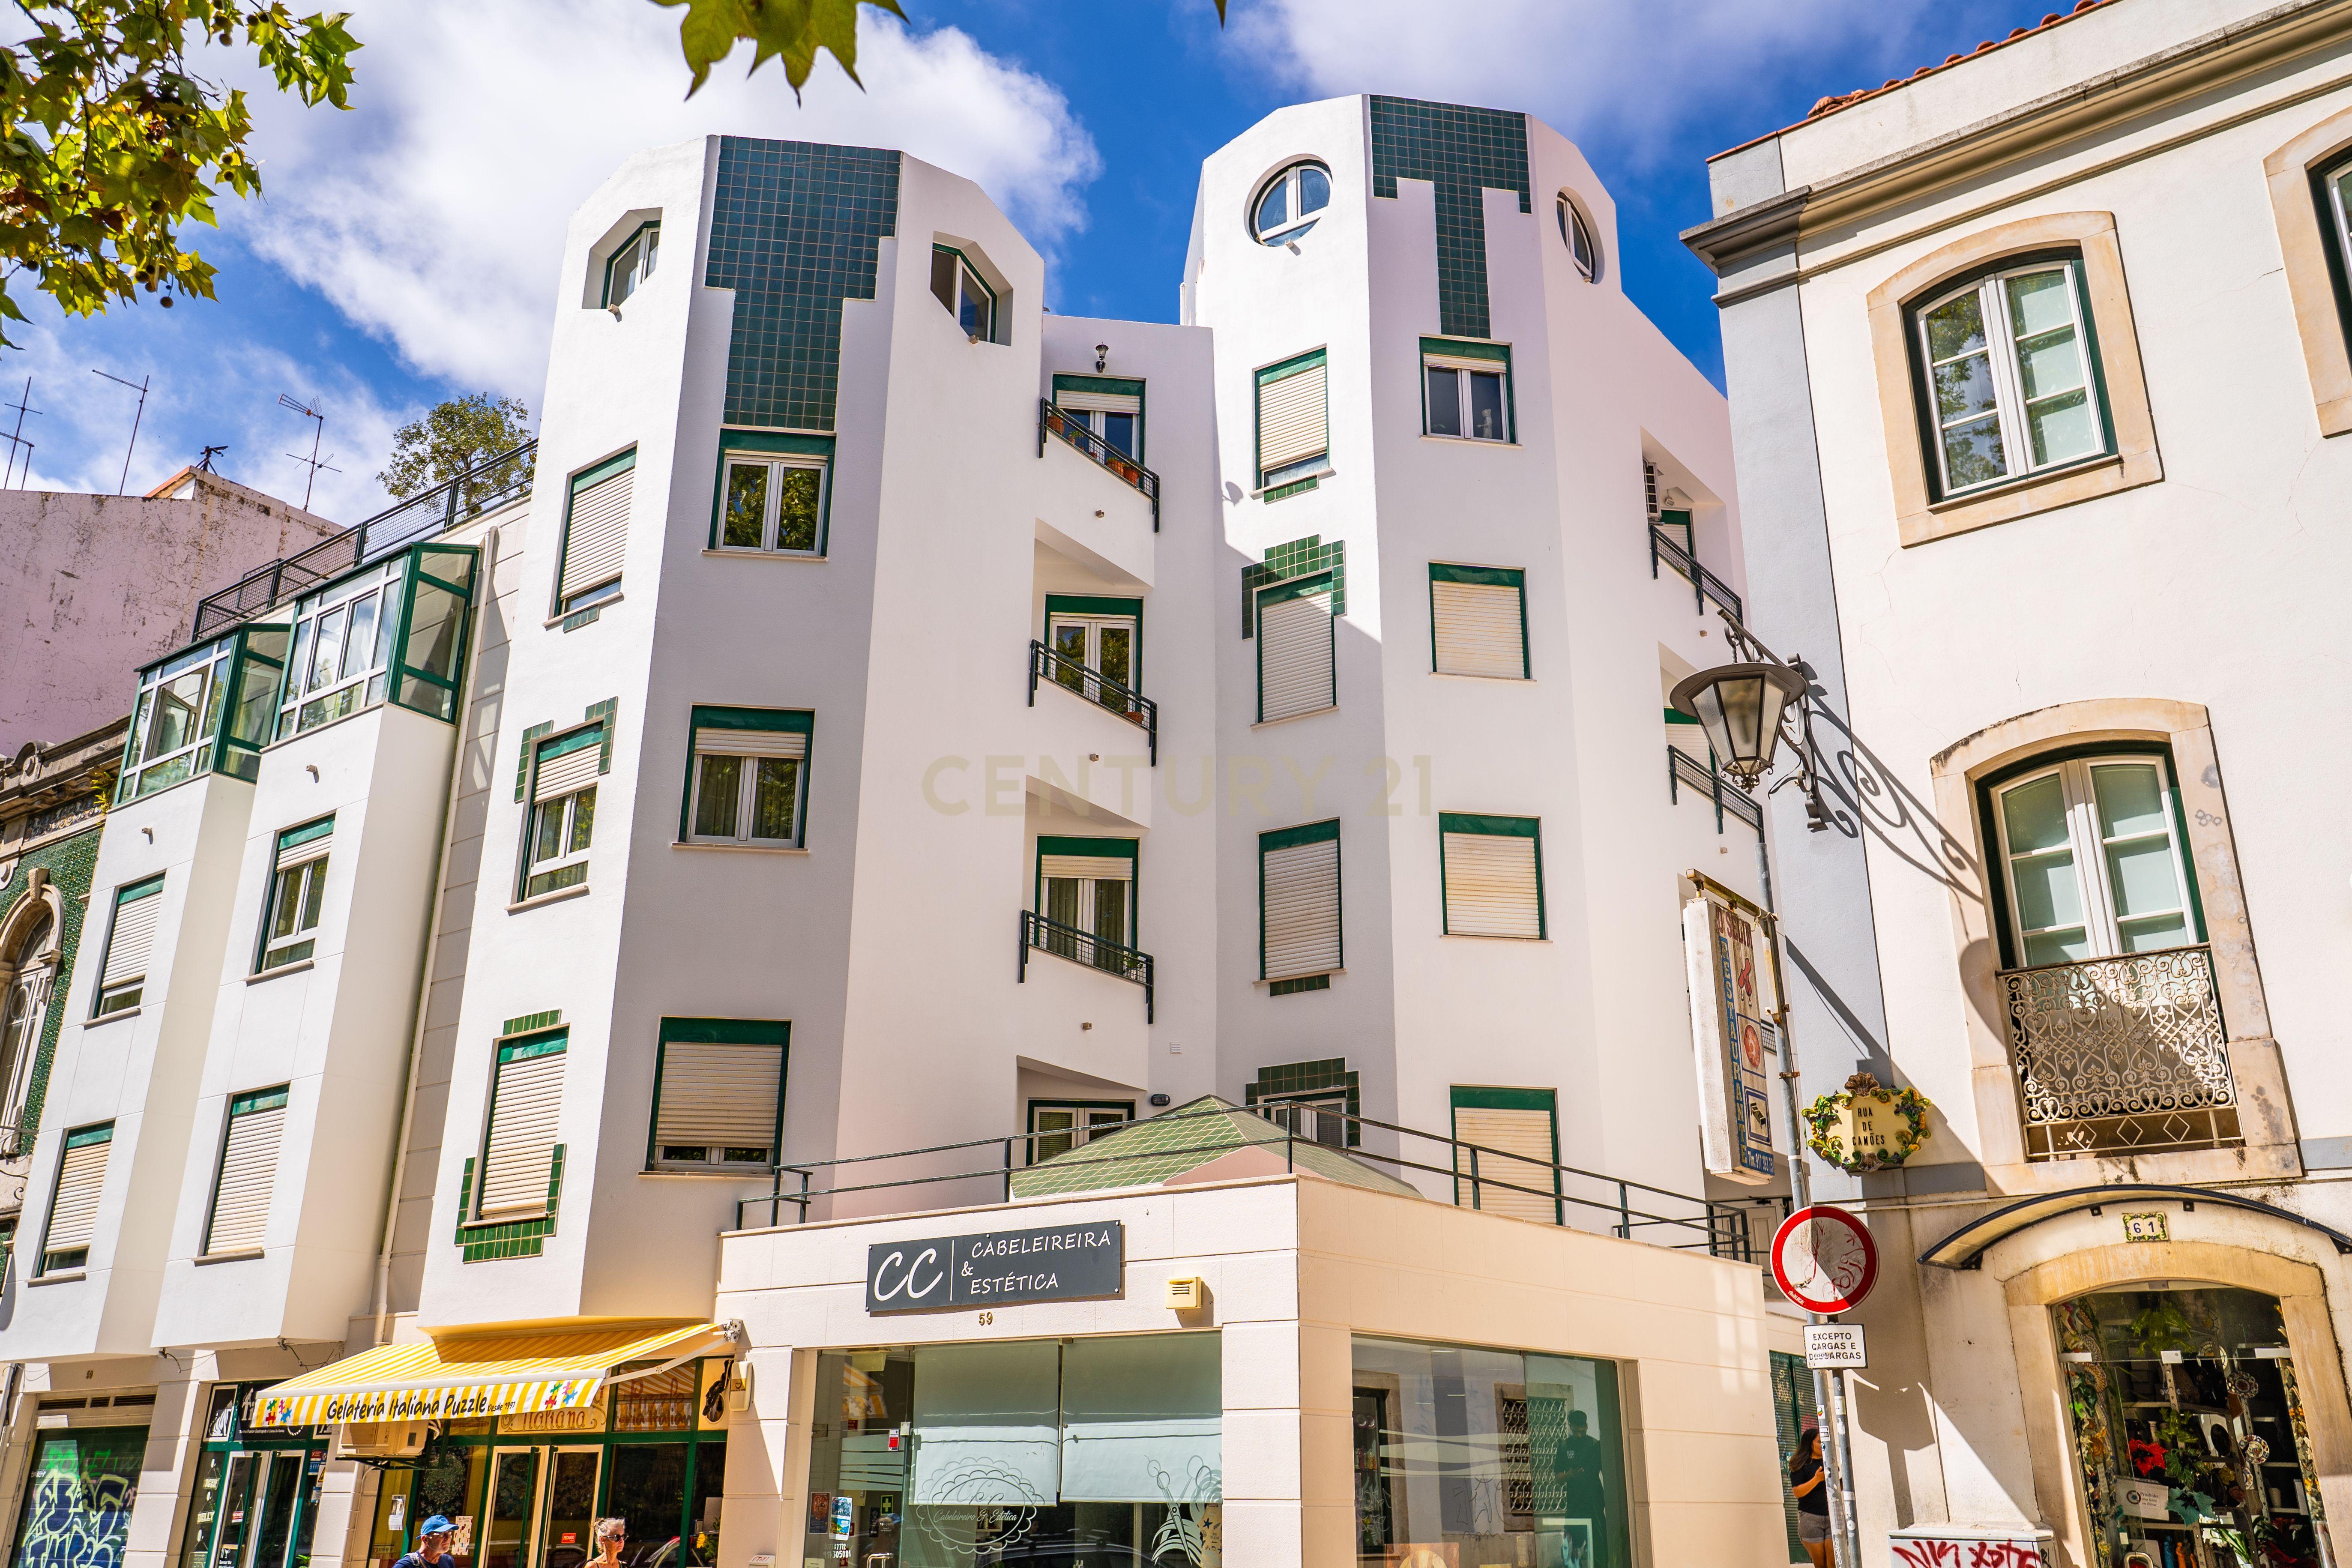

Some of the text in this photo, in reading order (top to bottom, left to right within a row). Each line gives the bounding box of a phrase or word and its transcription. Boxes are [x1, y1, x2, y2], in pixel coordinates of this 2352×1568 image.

[1721, 940, 1748, 1164] RESTAURANTE
[1857, 1107, 1873, 1118] RUA
[1862, 1121, 1872, 1131] DE
[1852, 1132, 1885, 1146] CAMÕES
[2133, 1221, 2155, 1233] 61
[972, 1230, 1111, 1258] CABELEIREIRA
[874, 1248, 943, 1301] CC
[961, 1261, 974, 1277] &
[970, 1271, 1058, 1294] ESTÉTICA
[979, 1311, 993, 1326] 59
[1813, 1332, 1852, 1341] EXCEPTO
[1812, 1342, 1846, 1350] CARGAS
[327, 1392, 516, 1420] Gelateria Italiana Puzzle Desde 1997
[934, 1509, 976, 1523] Cabeleireiro
